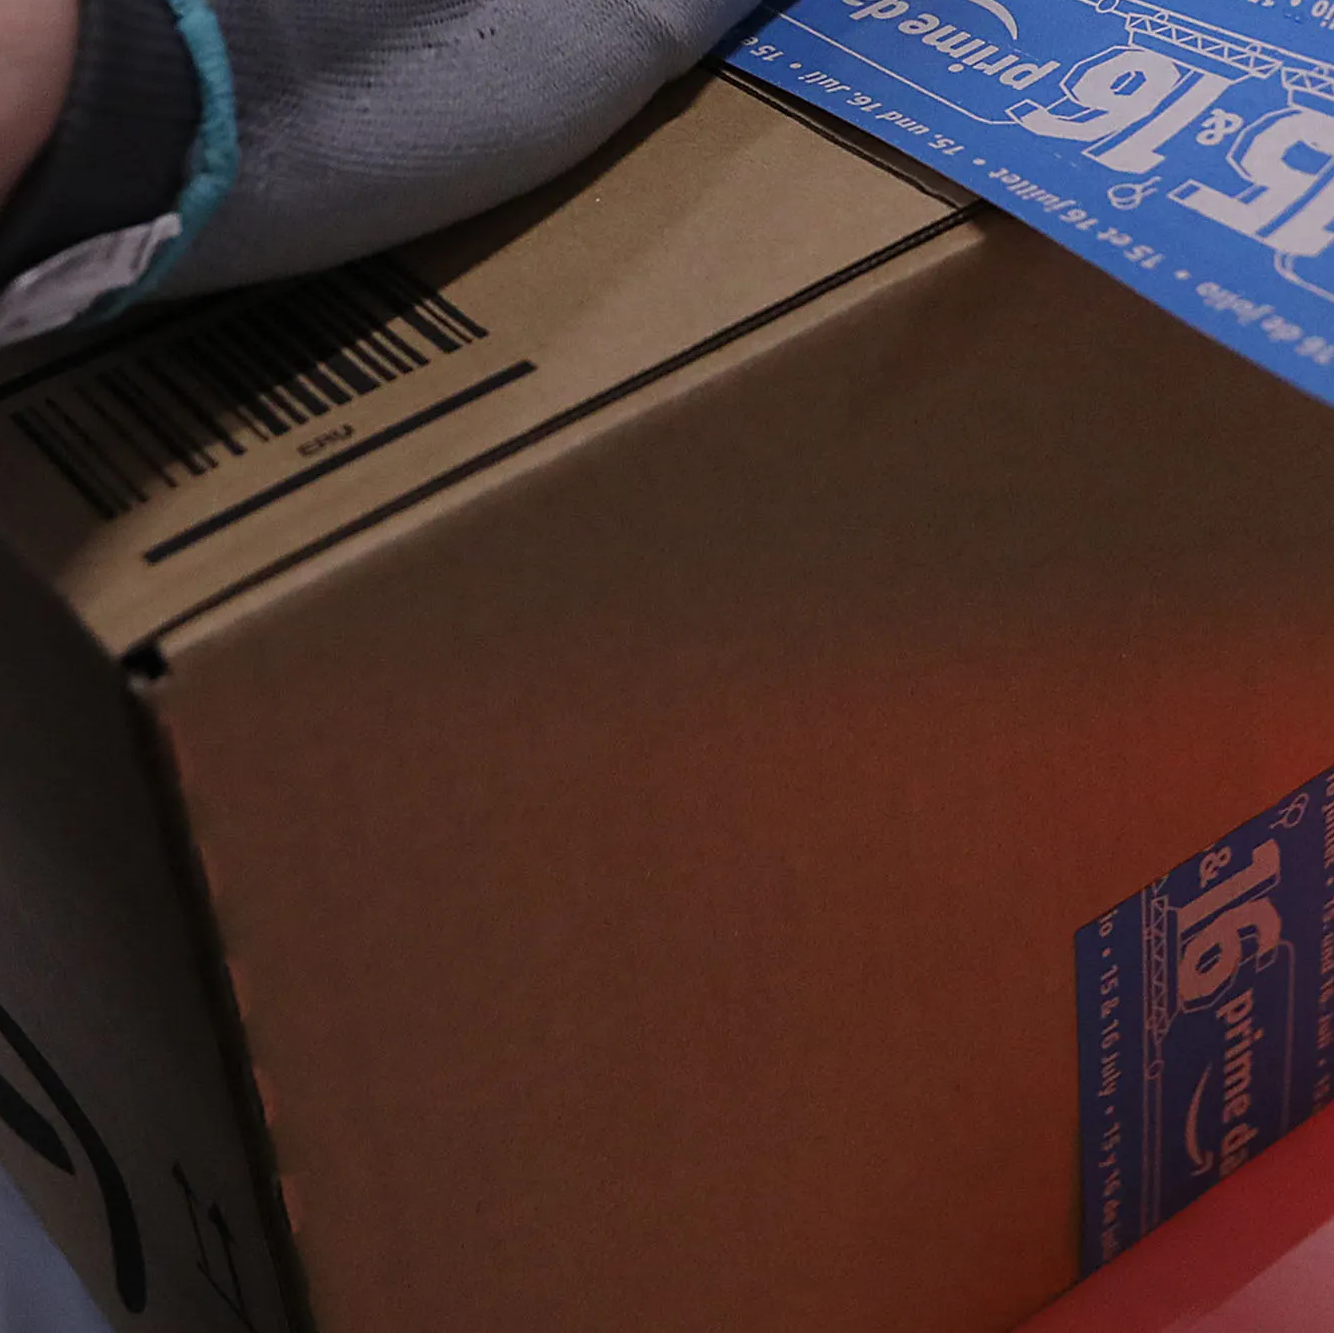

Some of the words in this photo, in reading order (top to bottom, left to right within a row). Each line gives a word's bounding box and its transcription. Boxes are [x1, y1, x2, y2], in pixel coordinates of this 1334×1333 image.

[749, 44, 786, 62] 15
[898, 13, 1061, 90] prime
[797, 70, 851, 94] Juli
[845, 91, 883, 113] 16.
[1007, 46, 1232, 174] 16
[874, 110, 931, 136] und
[1195, 108, 1245, 146] &
[928, 134, 966, 156] 15.
[988, 167, 1077, 213] juillet
[1059, 208, 1099, 231] 16
[1096, 227, 1133, 246] et
[1124, 244, 1165, 269] 15
[1200, 845, 1232, 888] &
[1177, 838, 1282, 1014] 16
[1100, 964, 1119, 996] 15
[1100, 1018, 1121, 1050] 16
[1216, 988, 1265, 1123] prime
[1100, 1122, 1121, 1152] 15
[1219, 1122, 1260, 1177] da
